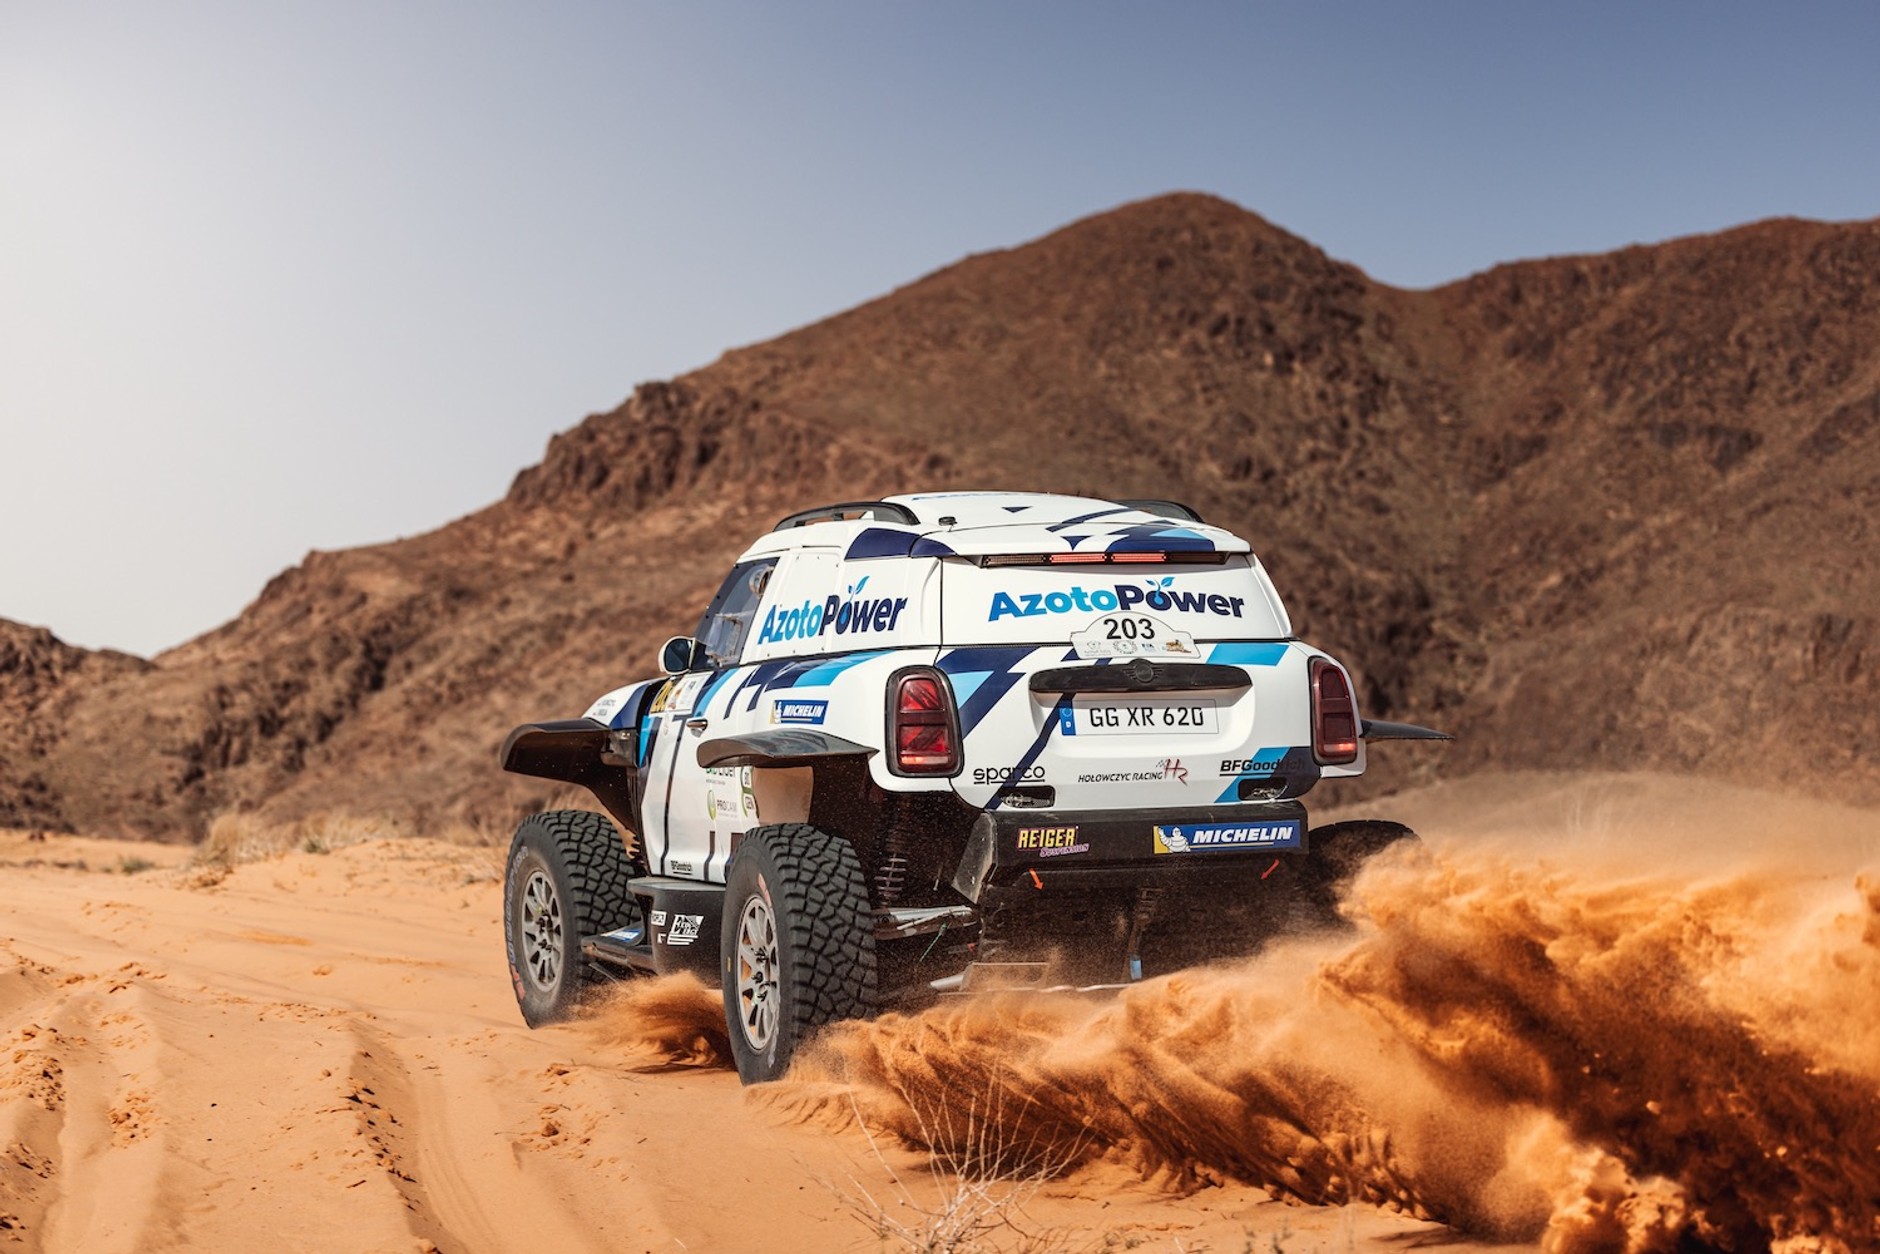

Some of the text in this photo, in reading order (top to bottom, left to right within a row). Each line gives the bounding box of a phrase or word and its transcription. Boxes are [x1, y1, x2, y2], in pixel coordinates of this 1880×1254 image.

[988, 584, 1246, 622] AzotoPower
[757, 594, 909, 645] AzotoPower
[1103, 618, 1156, 640] 203
[782, 704, 825, 717] MICHELIN
[1090, 706, 1204, 727] GG XR 620
[973, 766, 1045, 785] sparco
[1078, 771, 1163, 783] HOŁOWCZYC RACING
[1018, 827, 1076, 849] REIGER
[1192, 826, 1294, 844] MICHELIN
